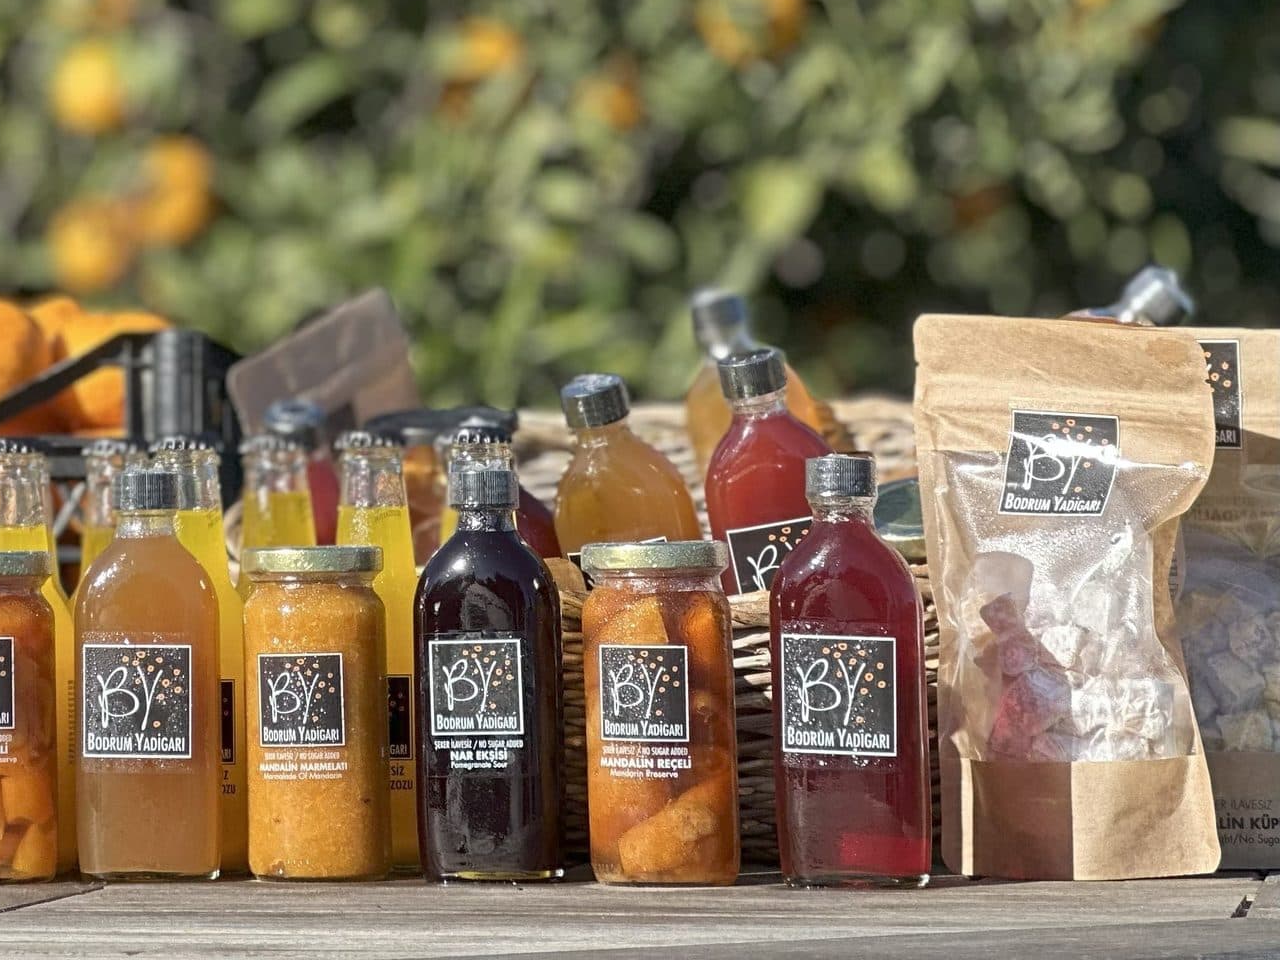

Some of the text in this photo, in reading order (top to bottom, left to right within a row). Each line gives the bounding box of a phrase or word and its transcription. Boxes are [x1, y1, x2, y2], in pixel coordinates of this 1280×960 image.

[1004, 493, 1051, 511] BODRUM
[442, 658, 497, 712] BY
[609, 663, 665, 718] BY
[796, 658, 866, 726] BY
[96, 666, 163, 730] BY
[268, 671, 320, 724] BY
[436, 714, 475, 730] BODRUM
[604, 719, 639, 735] BODRUM
[87, 732, 132, 751] BODRUM
[263, 726, 297, 742] BODRUM
[787, 726, 835, 747] BODRUM
[478, 740, 487, 748] NO
[487, 739, 505, 748] SUGAR
[651, 746, 669, 755] SUGAR
[670, 746, 688, 756] ADDED
[450, 747, 508, 762] NAR EKŞİSİ
[657, 755, 692, 770] REÇELİ
[300, 761, 348, 771] MARMELATI
[493, 761, 508, 769] Sour
[1219, 812, 1280, 829] LİN KÜP
